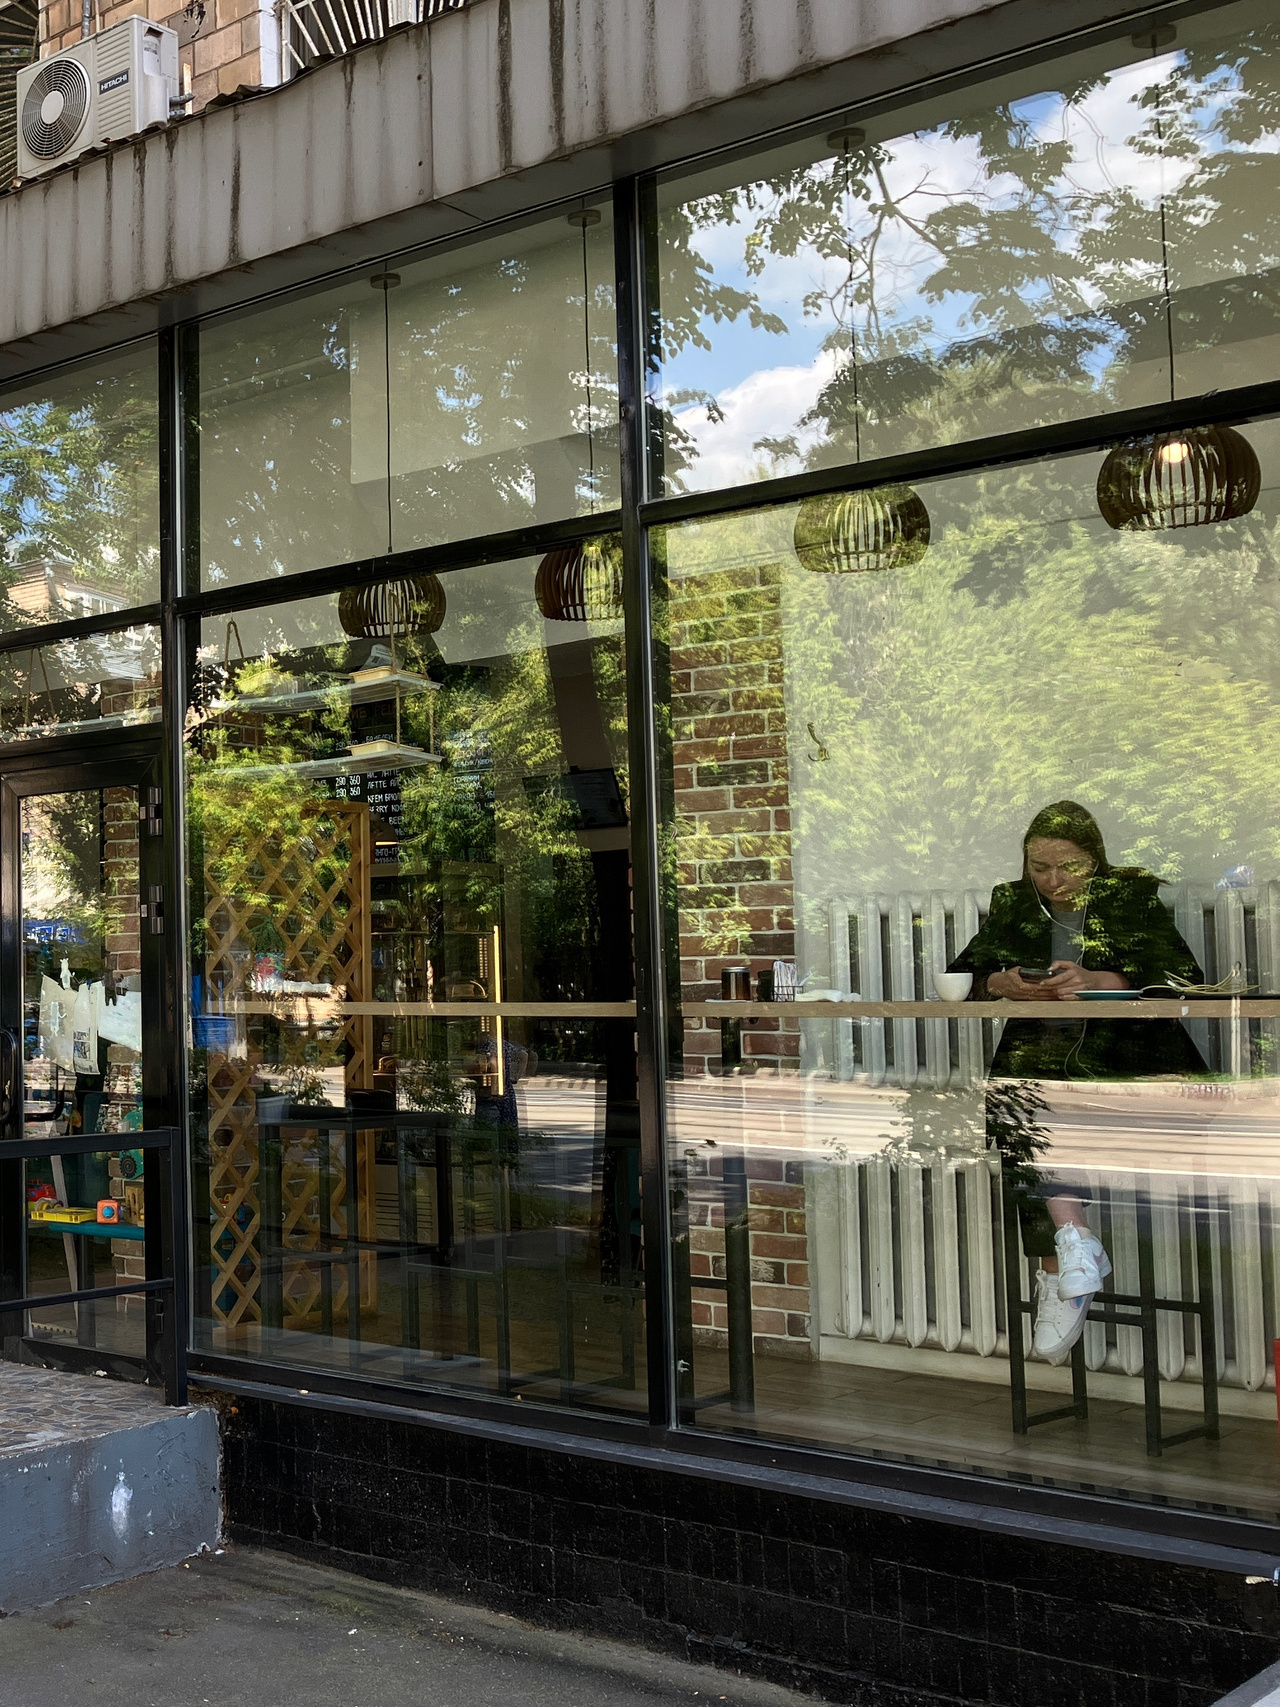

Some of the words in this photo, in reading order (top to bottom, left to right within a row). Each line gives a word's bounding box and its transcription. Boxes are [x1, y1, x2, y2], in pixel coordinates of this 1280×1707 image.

[101, 74, 127, 91] HITACHI
[335, 776, 347, 787] 290
[349, 774, 361, 786] 360
[349, 786, 361, 797] 360
